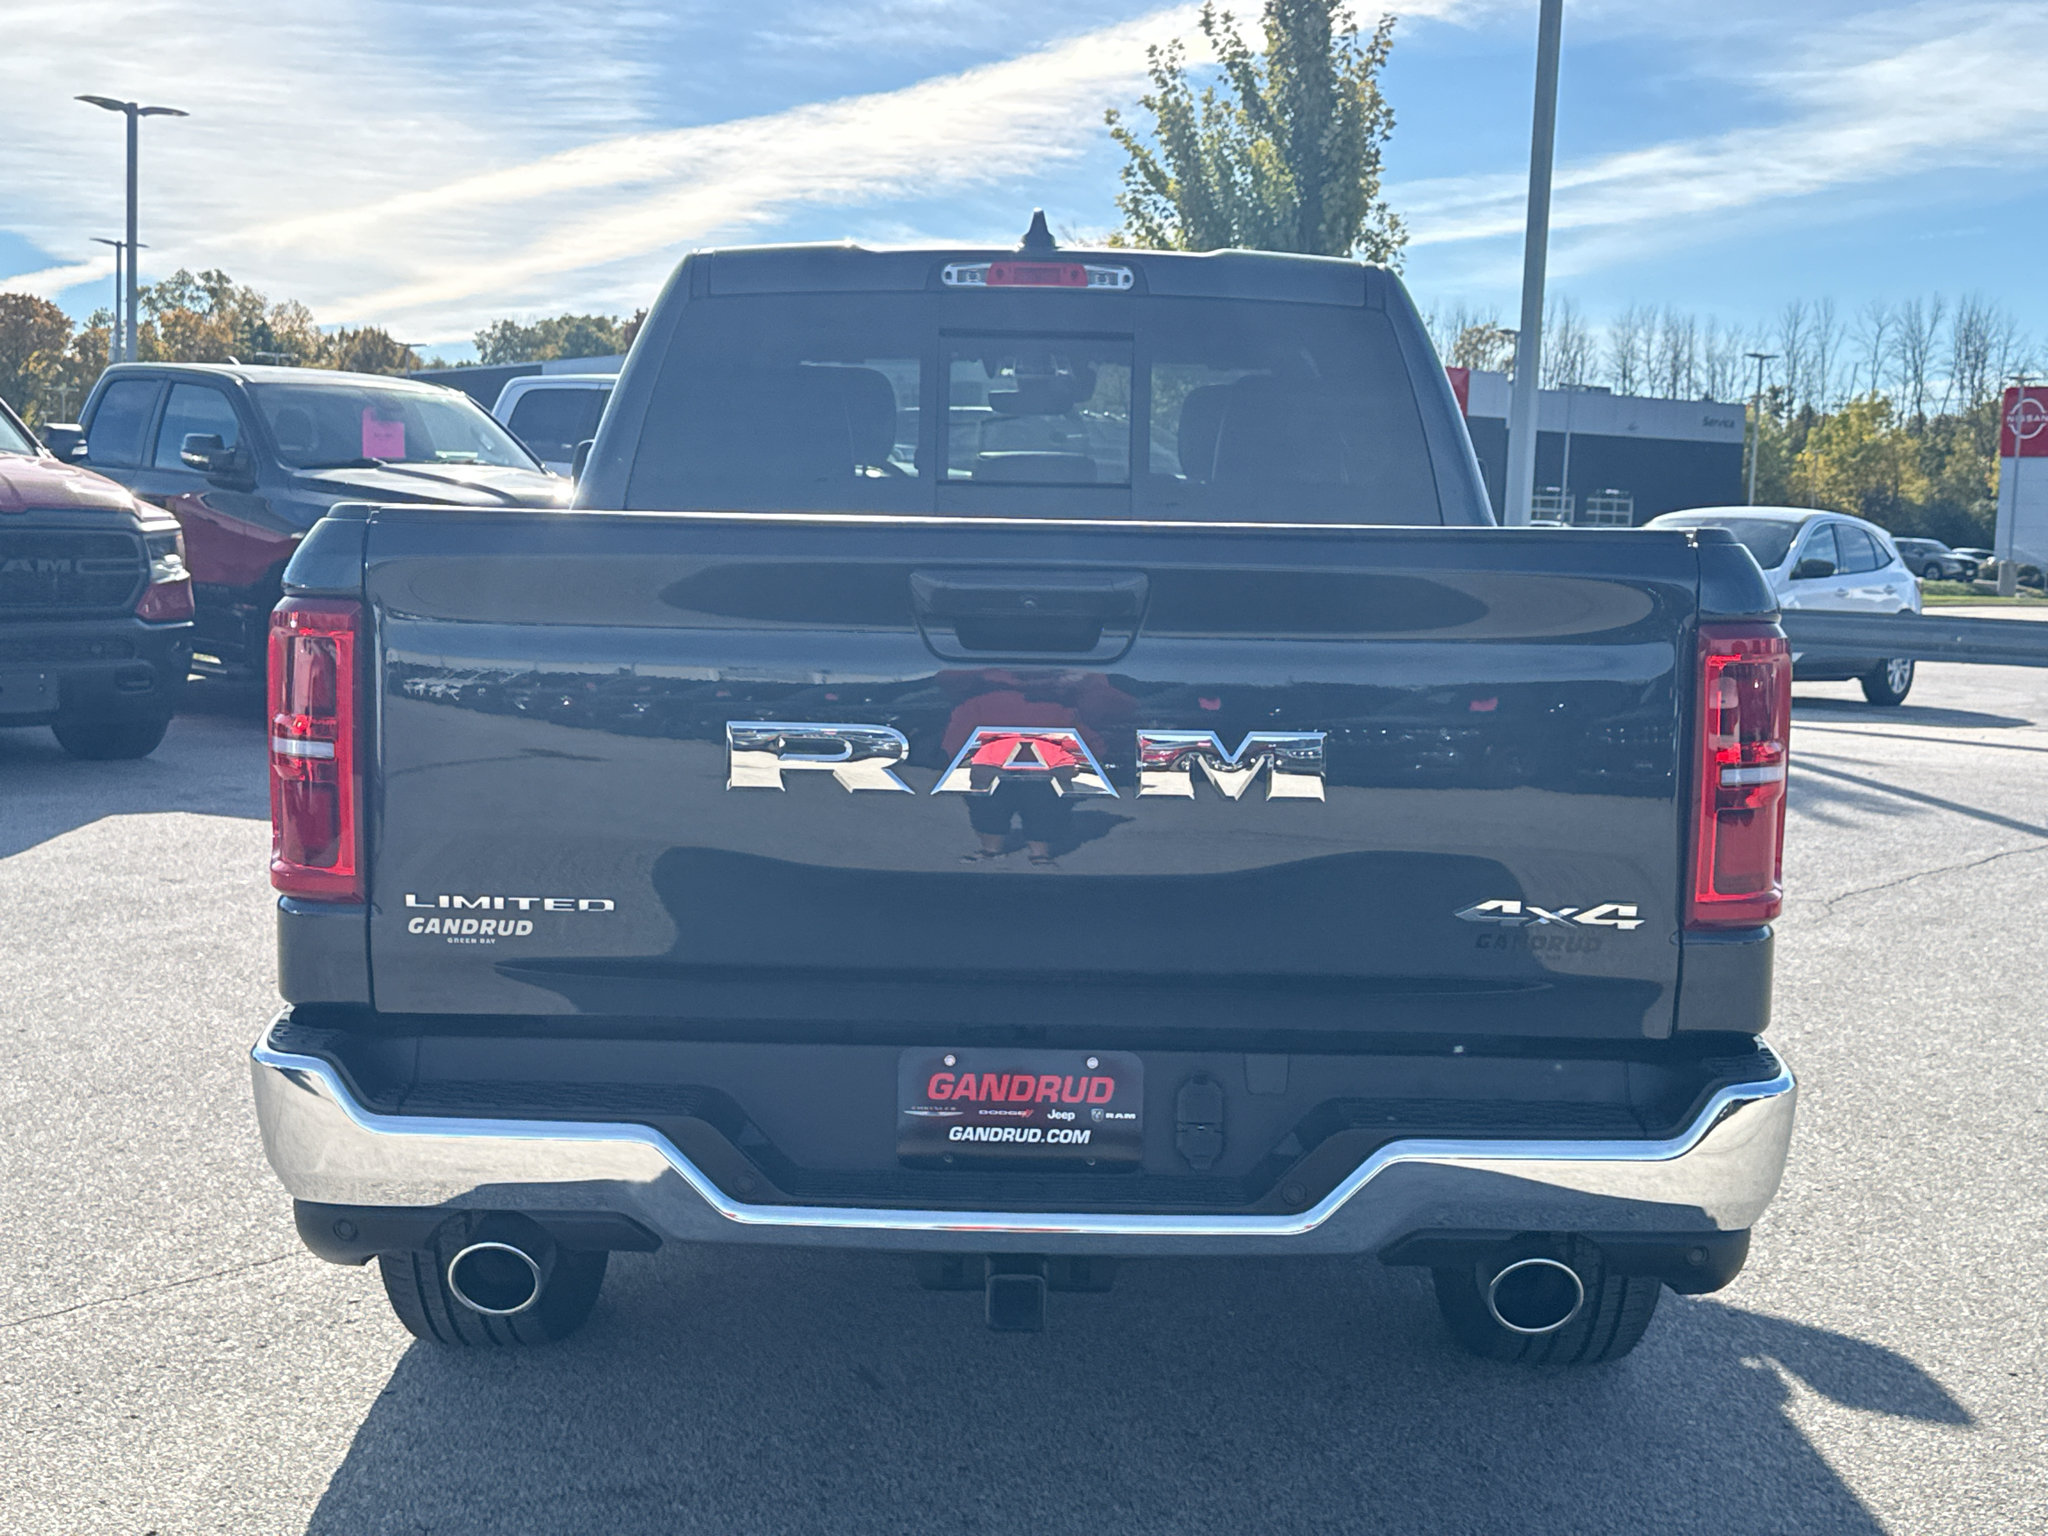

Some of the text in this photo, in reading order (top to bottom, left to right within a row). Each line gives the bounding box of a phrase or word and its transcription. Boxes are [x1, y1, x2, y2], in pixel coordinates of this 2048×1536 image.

[1, 558, 71, 573] AM
[725, 719, 1328, 802] RAM
[404, 893, 615, 912] LIMITED
[408, 916, 534, 937] GANDRUD
[927, 1072, 1115, 1104] GANDRUD
[1047, 1108, 1076, 1122] Jeep
[948, 1126, 1091, 1145] GANDRUD.COM
